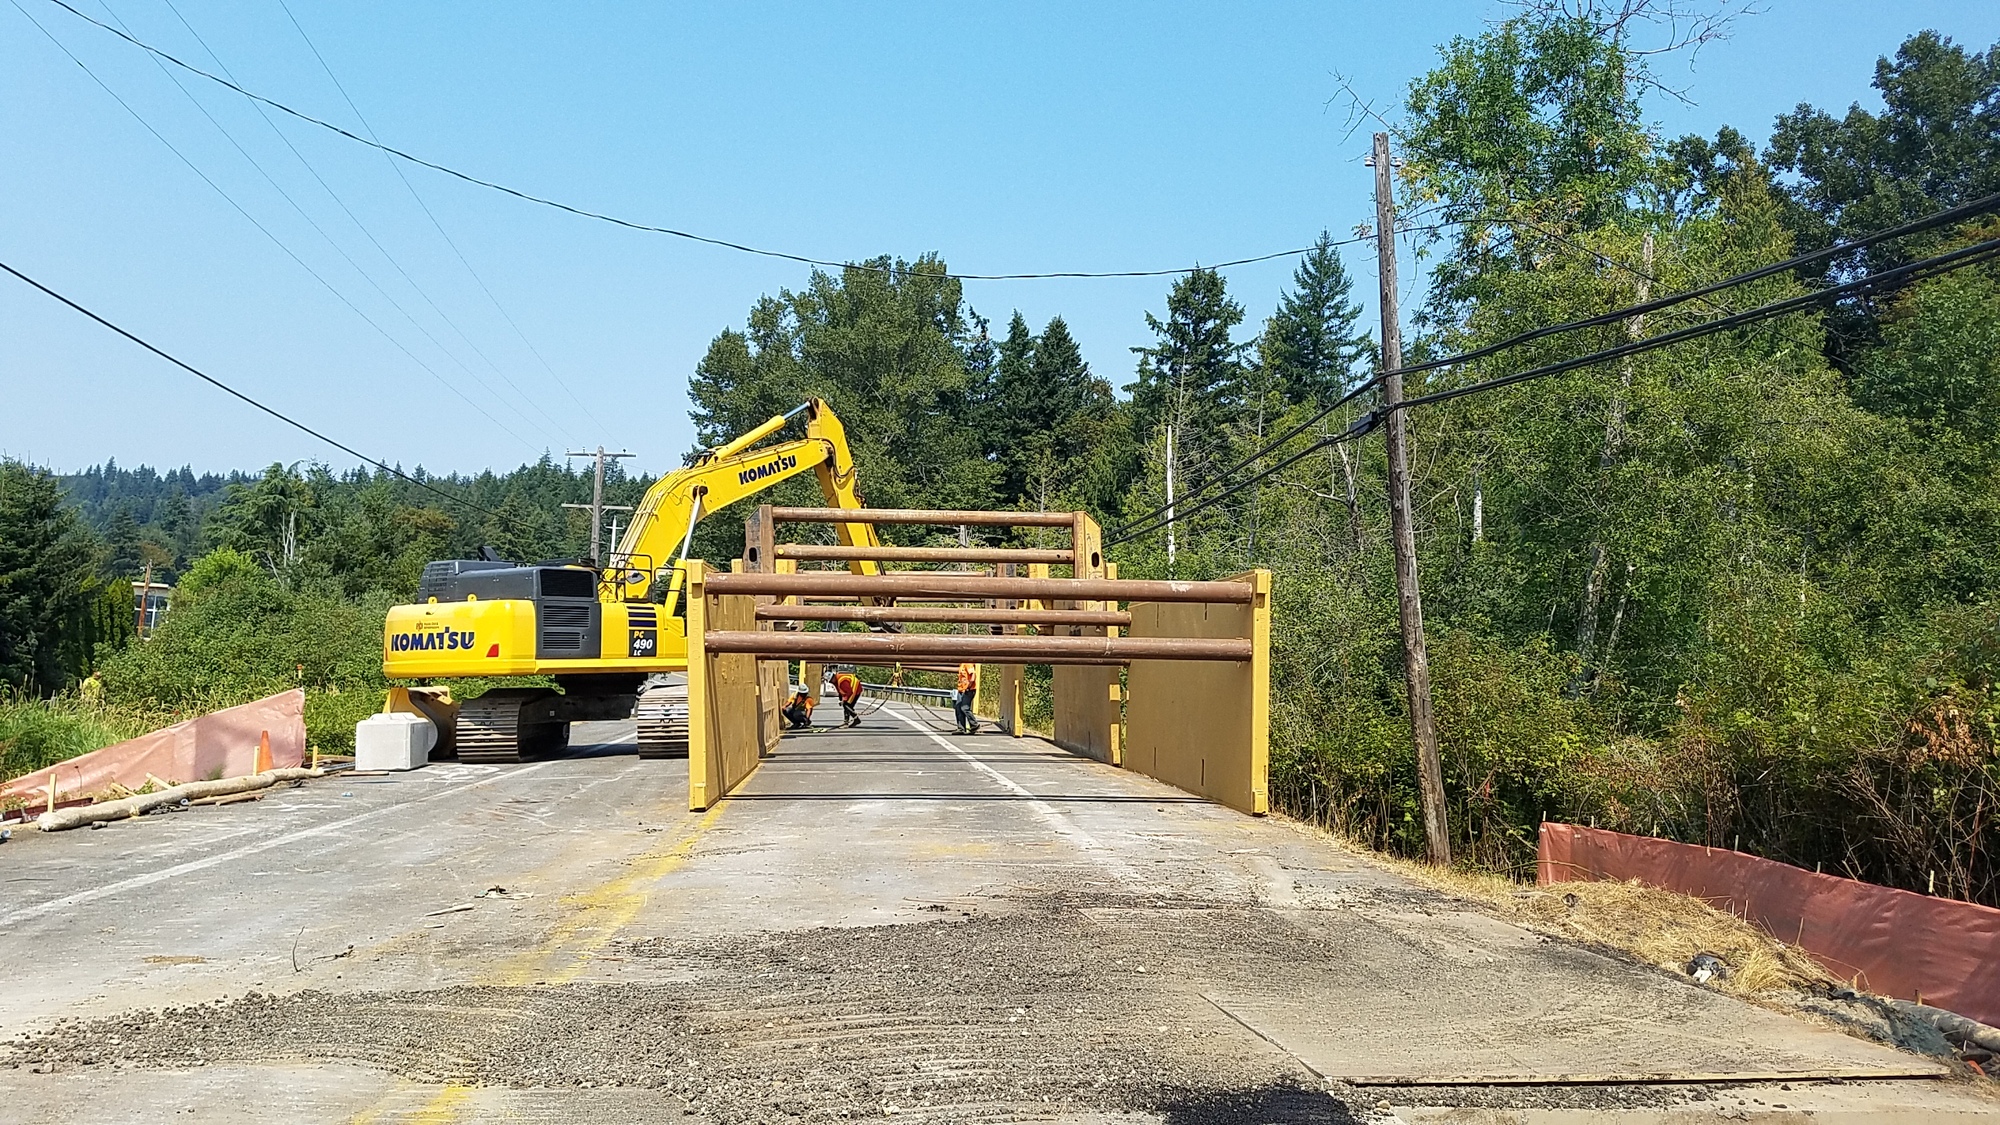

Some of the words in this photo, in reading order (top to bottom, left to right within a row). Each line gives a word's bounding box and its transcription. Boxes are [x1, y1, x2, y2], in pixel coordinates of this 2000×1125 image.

[739, 455, 797, 485] KOMATSU
[391, 626, 475, 652] KOMATSU
[633, 630, 645, 639] PC
[633, 638, 653, 650] 490
